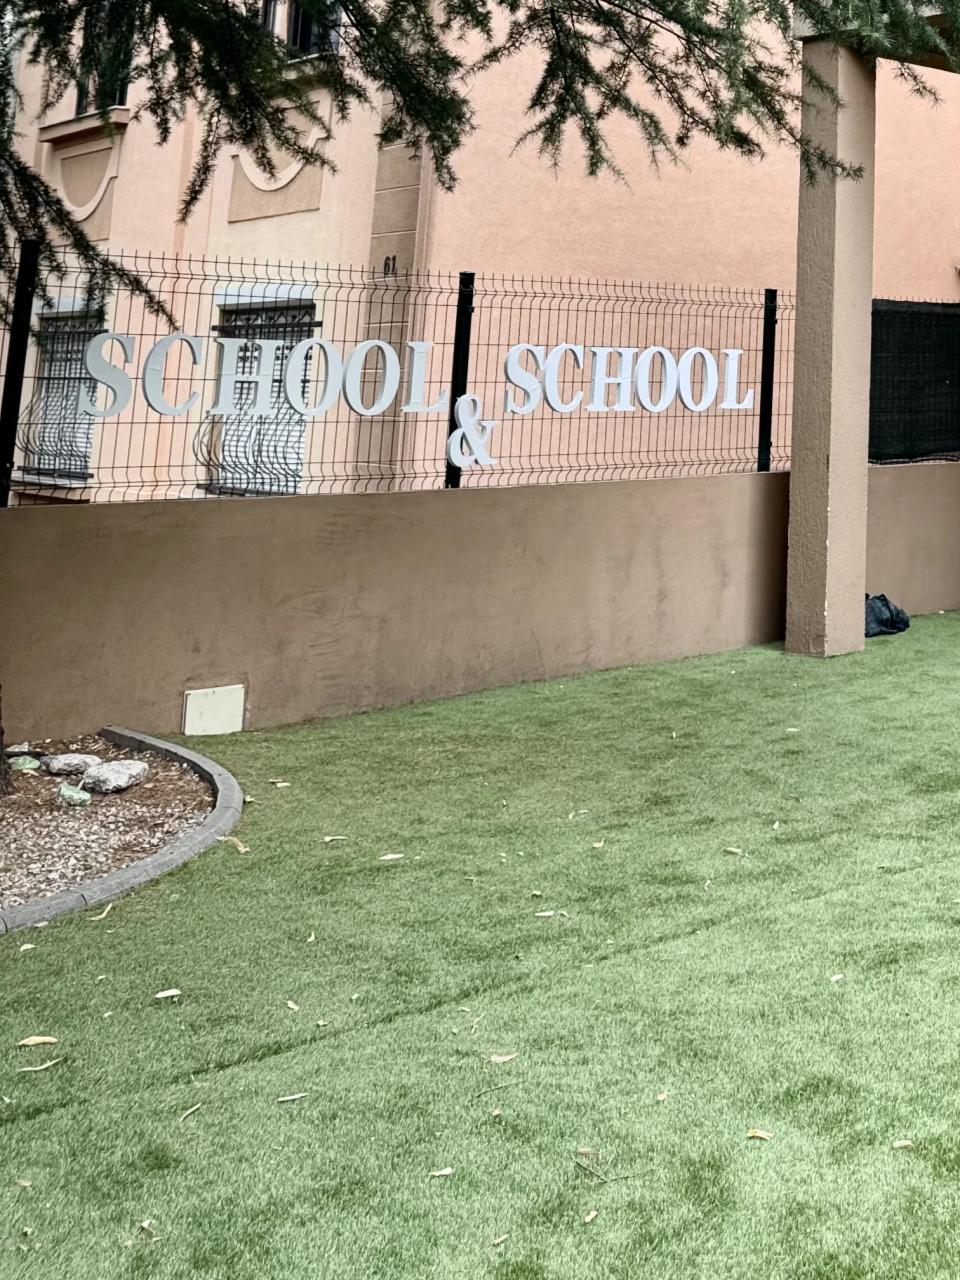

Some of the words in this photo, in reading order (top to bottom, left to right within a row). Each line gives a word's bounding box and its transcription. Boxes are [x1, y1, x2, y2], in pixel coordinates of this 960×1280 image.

[384, 255, 396, 275] 61
[79, 332, 448, 417] SCHOOL
[447, 393, 499, 467] &
[504, 342, 755, 414] SCHOOL
